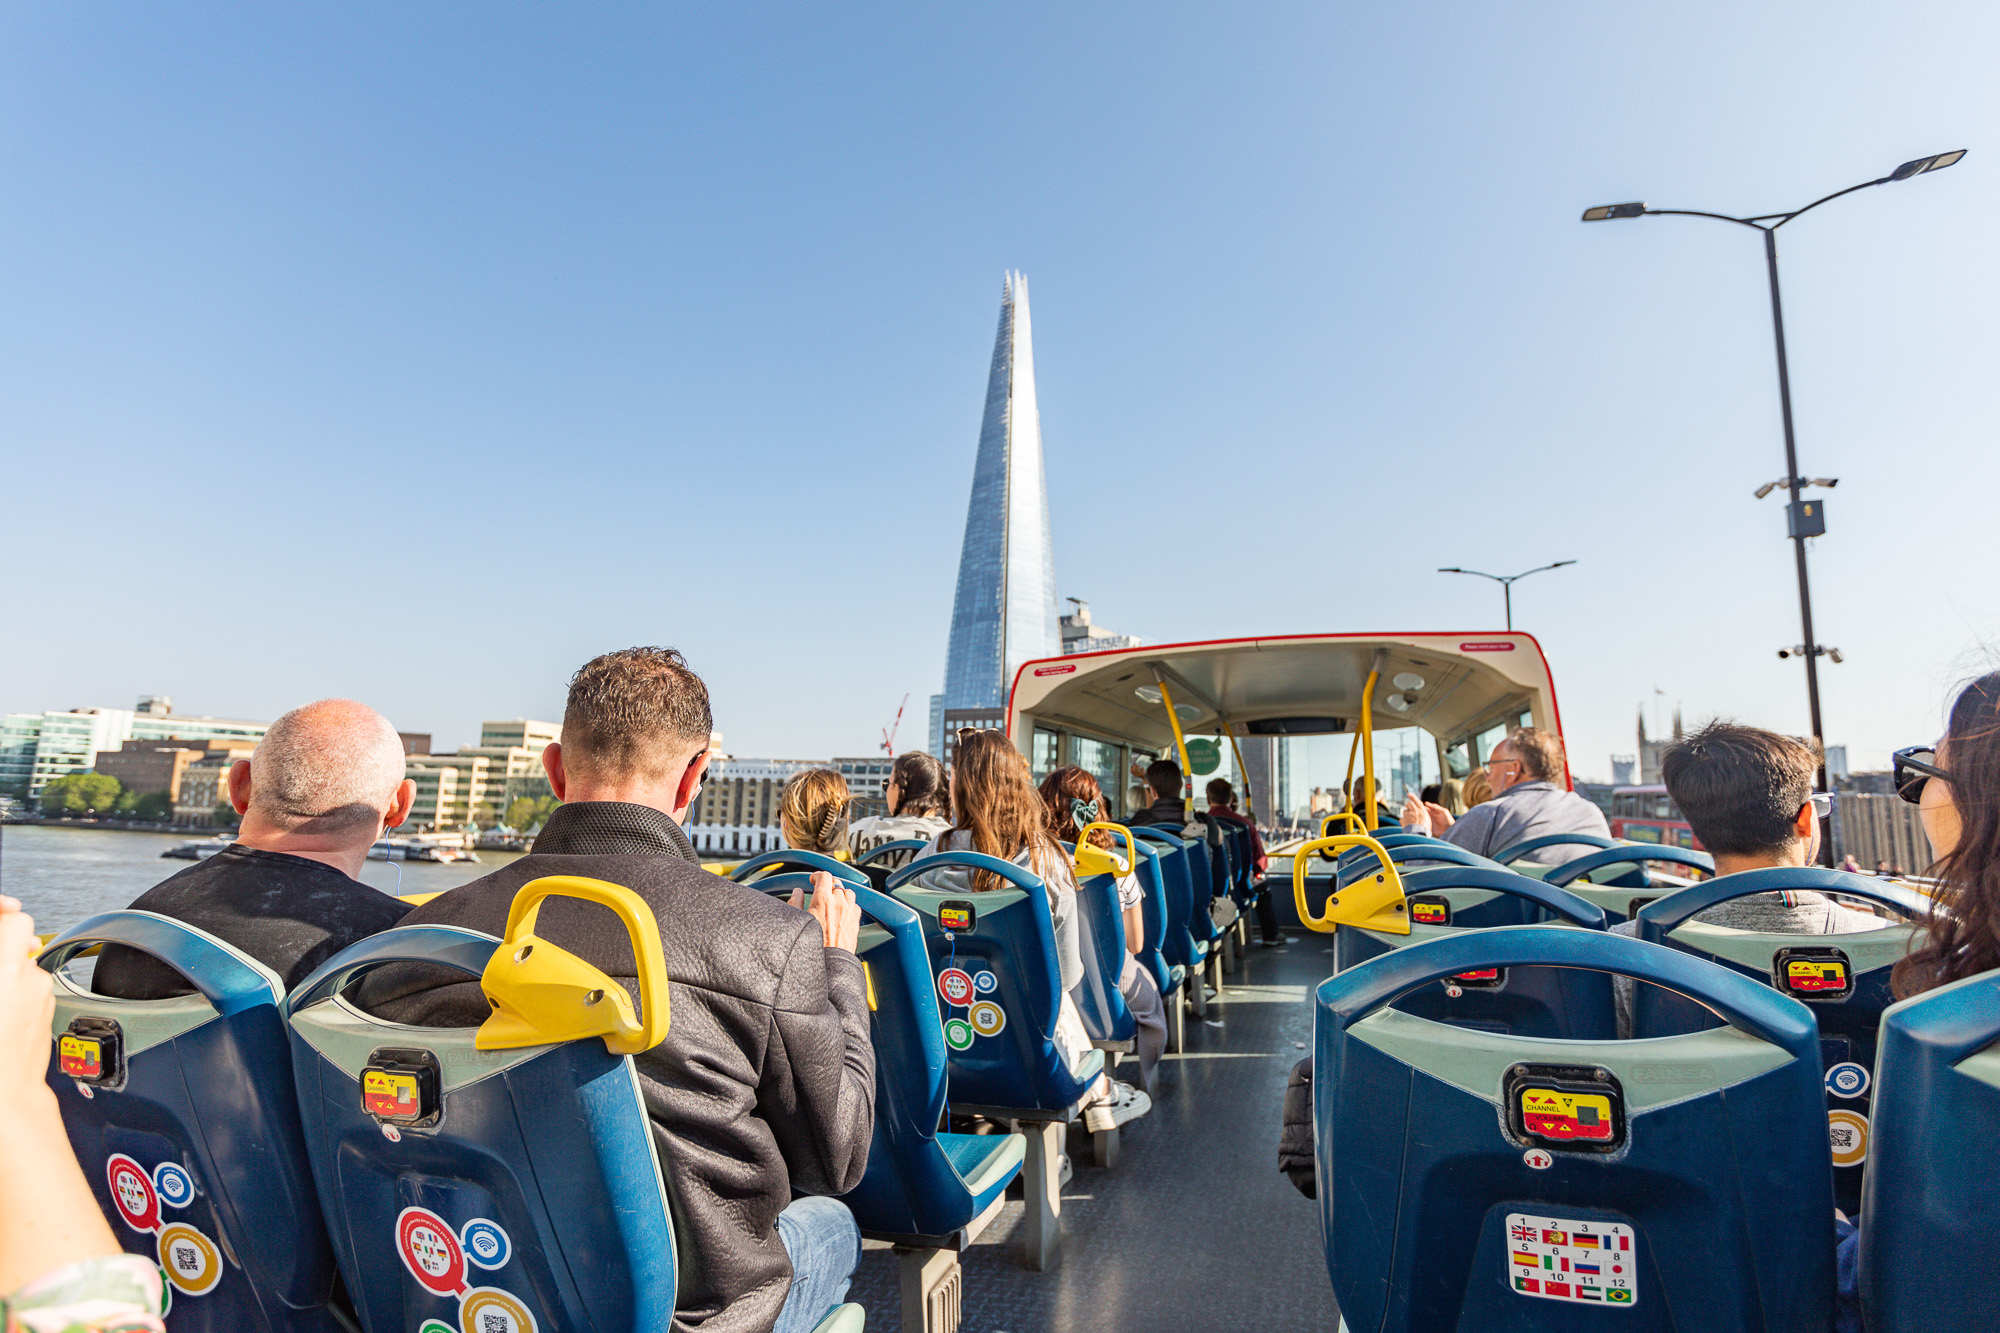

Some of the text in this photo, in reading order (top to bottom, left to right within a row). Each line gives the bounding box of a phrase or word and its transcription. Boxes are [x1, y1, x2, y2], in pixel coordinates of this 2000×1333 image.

[1526, 1104, 1561, 1113] CHANNEL
[1550, 1273, 1564, 1281] 10
[1581, 1276, 1594, 1284] 11
